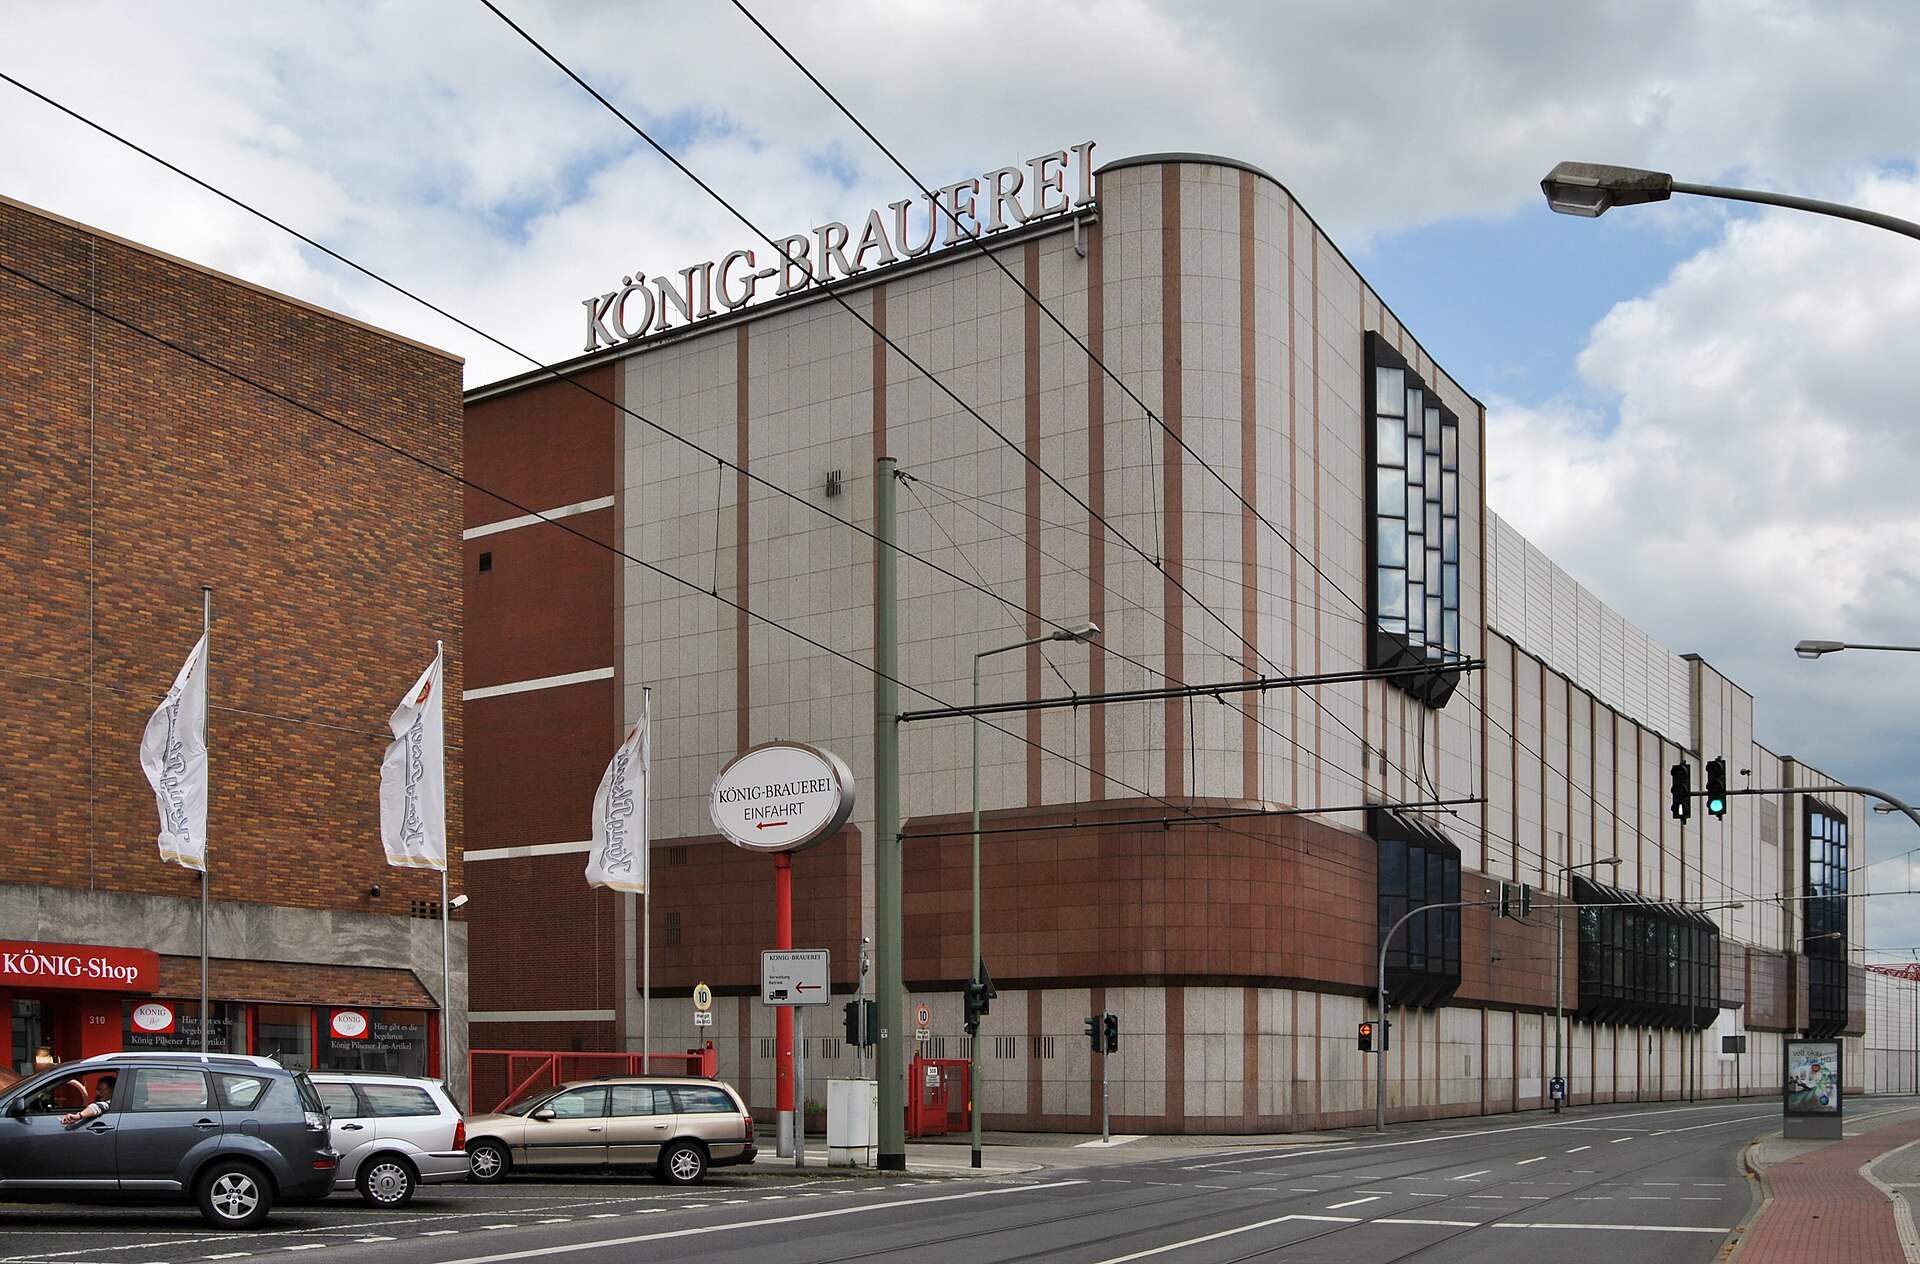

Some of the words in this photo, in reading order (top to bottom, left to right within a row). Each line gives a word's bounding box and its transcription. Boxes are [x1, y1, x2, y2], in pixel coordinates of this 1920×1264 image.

[582, 140, 1097, 352] KÖNIG-BRAUEREI
[719, 778, 831, 803] KÖNIG-BRAUEREI
[744, 802, 805, 821] EINFAHRT
[3, 949, 138, 984] KÖNIG-Shop
[698, 991, 707, 1003] 10
[89, 1016, 106, 1025] 310
[919, 1010, 927, 1022] 10
[131, 1035, 154, 1045] König
[186, 1037, 226, 1046] Fan-rtikel
